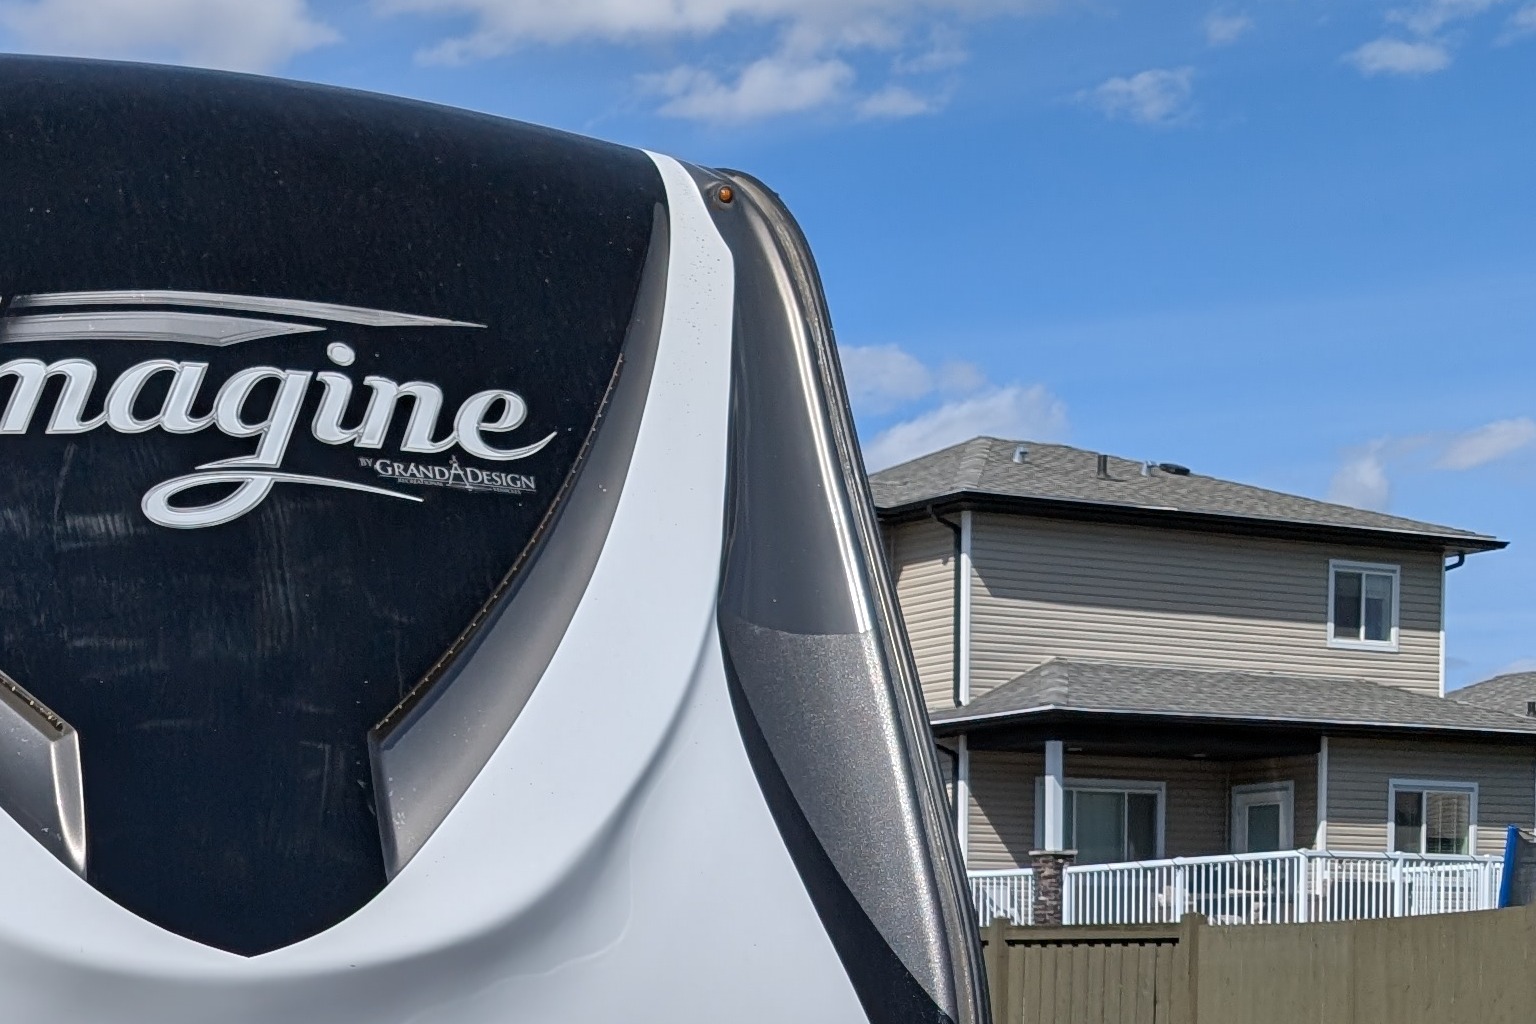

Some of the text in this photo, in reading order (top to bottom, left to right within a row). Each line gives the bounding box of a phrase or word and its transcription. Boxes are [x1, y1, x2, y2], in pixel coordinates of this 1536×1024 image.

[358, 457, 536, 489] BY GRAND DESIGN
